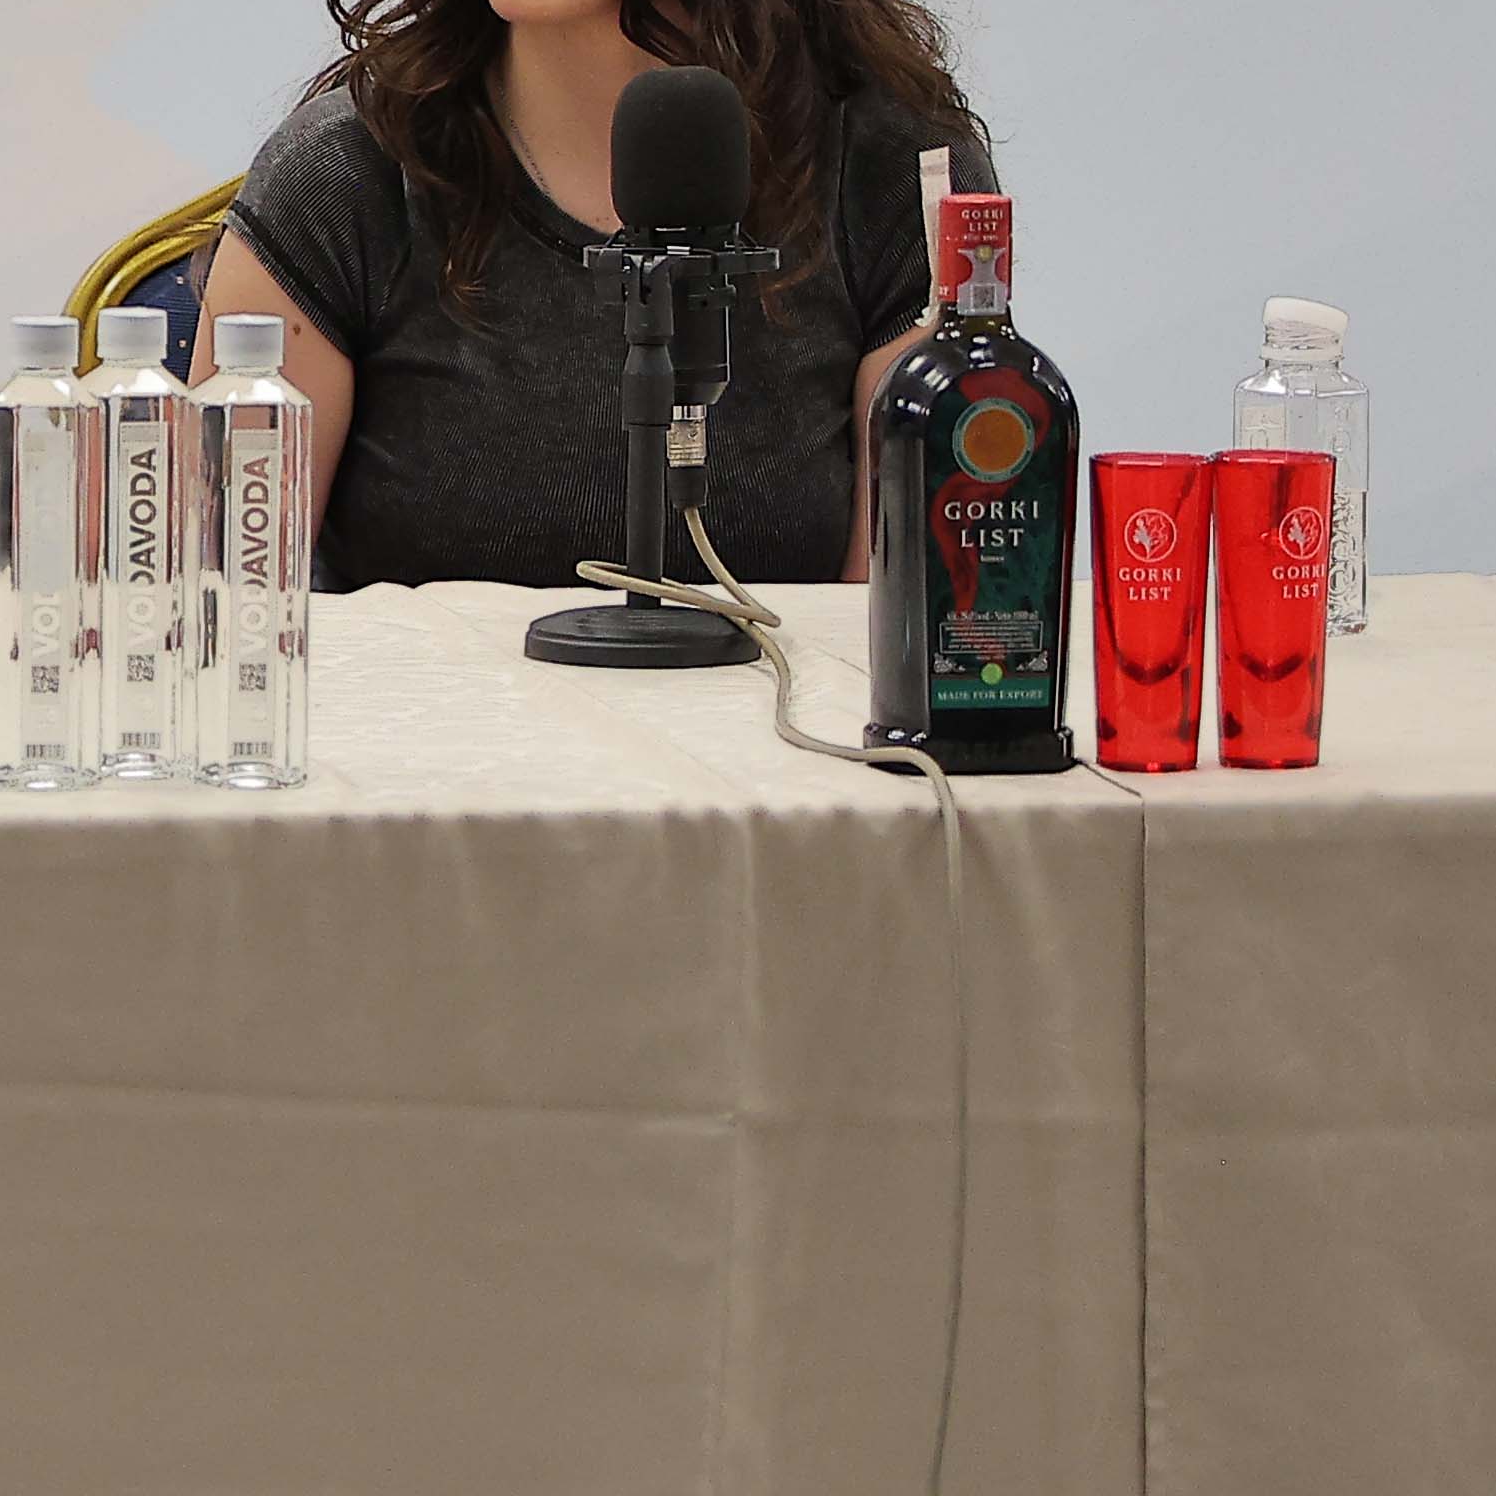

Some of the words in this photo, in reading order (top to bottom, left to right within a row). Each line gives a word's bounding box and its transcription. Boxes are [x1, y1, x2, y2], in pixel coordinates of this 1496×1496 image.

[943, 500, 1039, 521] GORKI
[960, 528, 1025, 548] LIST
[1118, 566, 1182, 583] GORKI
[1271, 563, 1326, 581] GORKI
[1128, 586, 1172, 602] LIST
[1282, 582, 1320, 600] LIST
